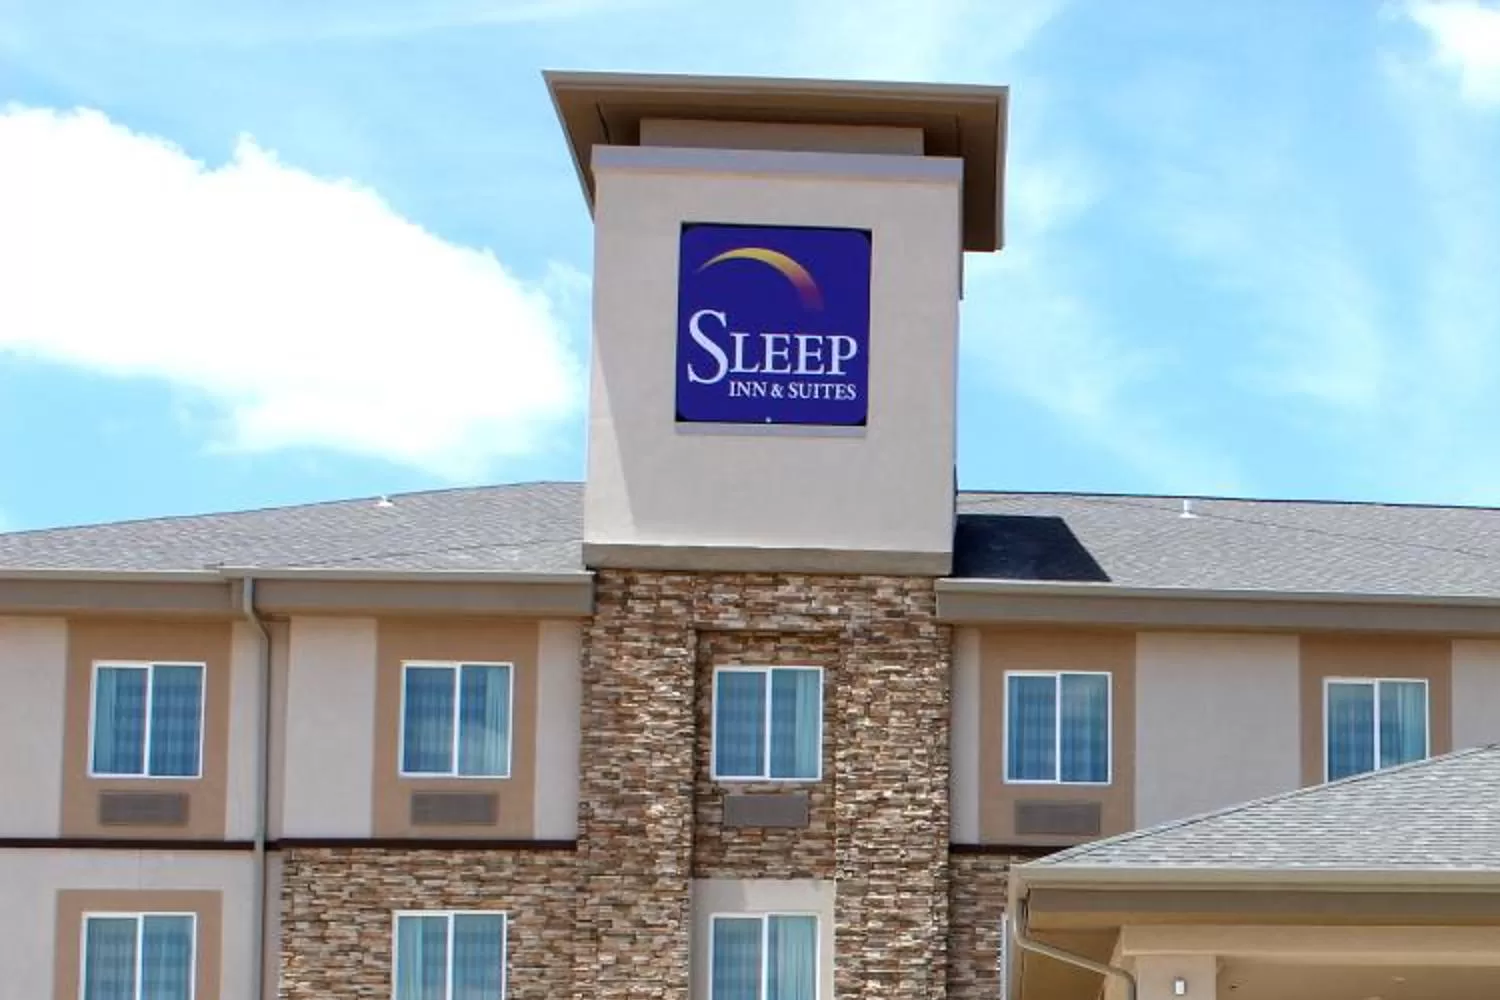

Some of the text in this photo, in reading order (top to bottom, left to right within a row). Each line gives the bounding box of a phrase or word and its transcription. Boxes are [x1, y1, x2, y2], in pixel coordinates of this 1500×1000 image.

[687, 309, 857, 384] SLEEP
[729, 381, 857, 400] INN & SUITES
